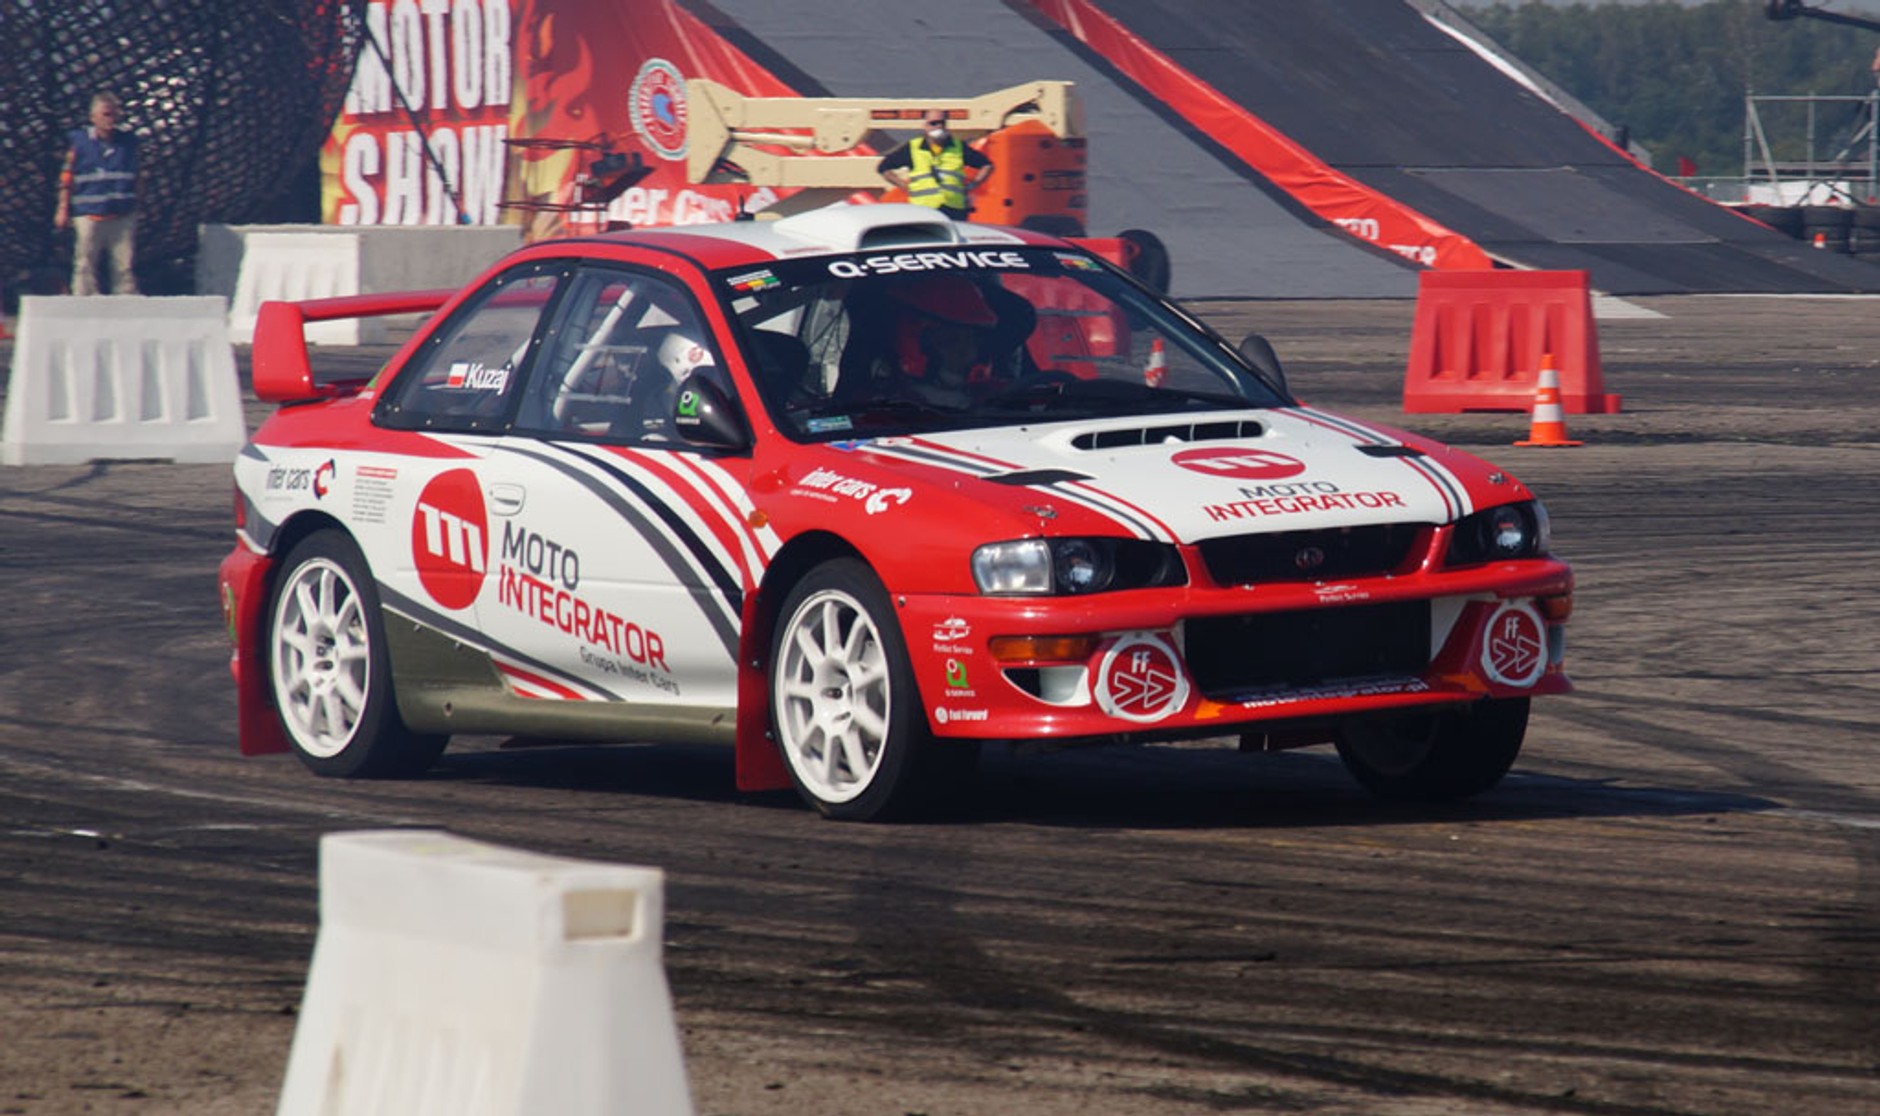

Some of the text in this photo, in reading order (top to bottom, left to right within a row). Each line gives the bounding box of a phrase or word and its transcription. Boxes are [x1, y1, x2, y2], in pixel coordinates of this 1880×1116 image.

[342, 0, 511, 114] MOTOR
[339, 124, 508, 224] SHOW
[465, 363, 511, 395] Kuzaj
[831, 477, 877, 500] cars
[1238, 480, 1340, 499] MOTO
[1202, 491, 1407, 522] INTEGRATOR
[501, 519, 579, 591] MOTO
[498, 563, 672, 674] INTEGRATOR
[1504, 617, 1520, 640] FF
[1131, 651, 1151, 673] FF
